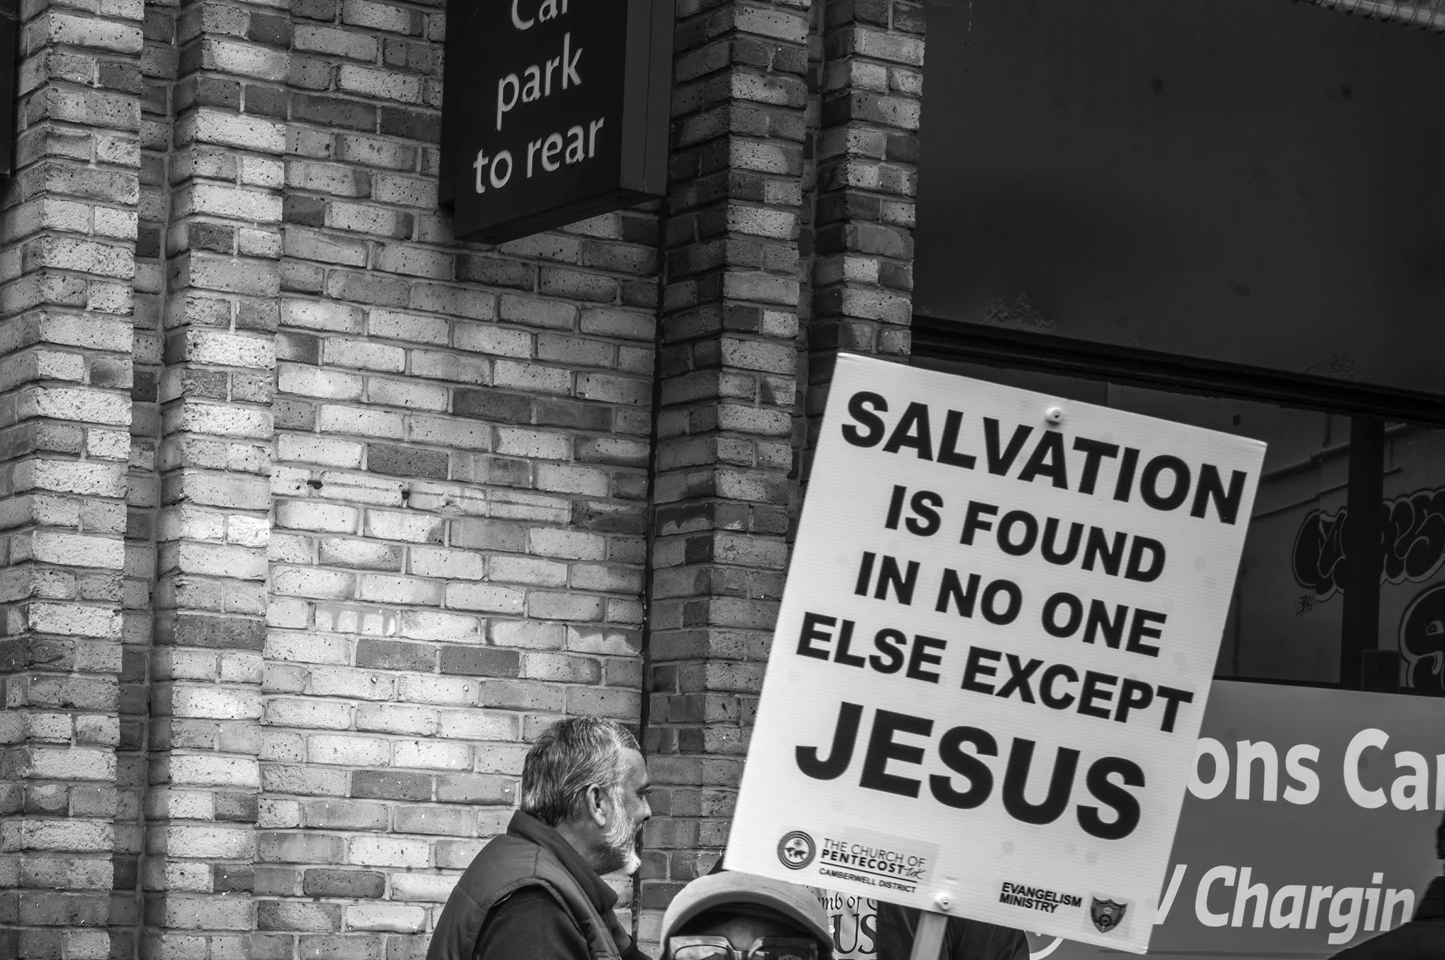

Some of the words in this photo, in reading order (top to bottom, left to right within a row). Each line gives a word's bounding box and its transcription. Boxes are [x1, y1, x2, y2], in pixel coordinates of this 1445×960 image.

[496, 32, 583, 131] park
[473, 149, 513, 194] to
[526, 116, 605, 179] rear
[841, 390, 1247, 525] SALVATION
[884, 484, 944, 537] IS
[959, 500, 1166, 583] FOUND
[854, 551, 920, 606] IN
[935, 567, 1023, 625] NO
[1042, 592, 1168, 658] ONE
[795, 611, 947, 684] ELSE
[961, 646, 1194, 733] EXCEPT
[795, 701, 1146, 840] JESUS
[819, 867, 877, 886] CAMBERWELL
[878, 880, 917, 893] DISTRICT
[821, 849, 906, 875] PENTECOST
[824, 837, 848, 852] THE
[851, 843, 905, 864] CHURCH
[907, 855, 926, 868] OF
[1001, 881, 1083, 908] EVANGELISM
[999, 892, 1059, 914] MINISTRY
